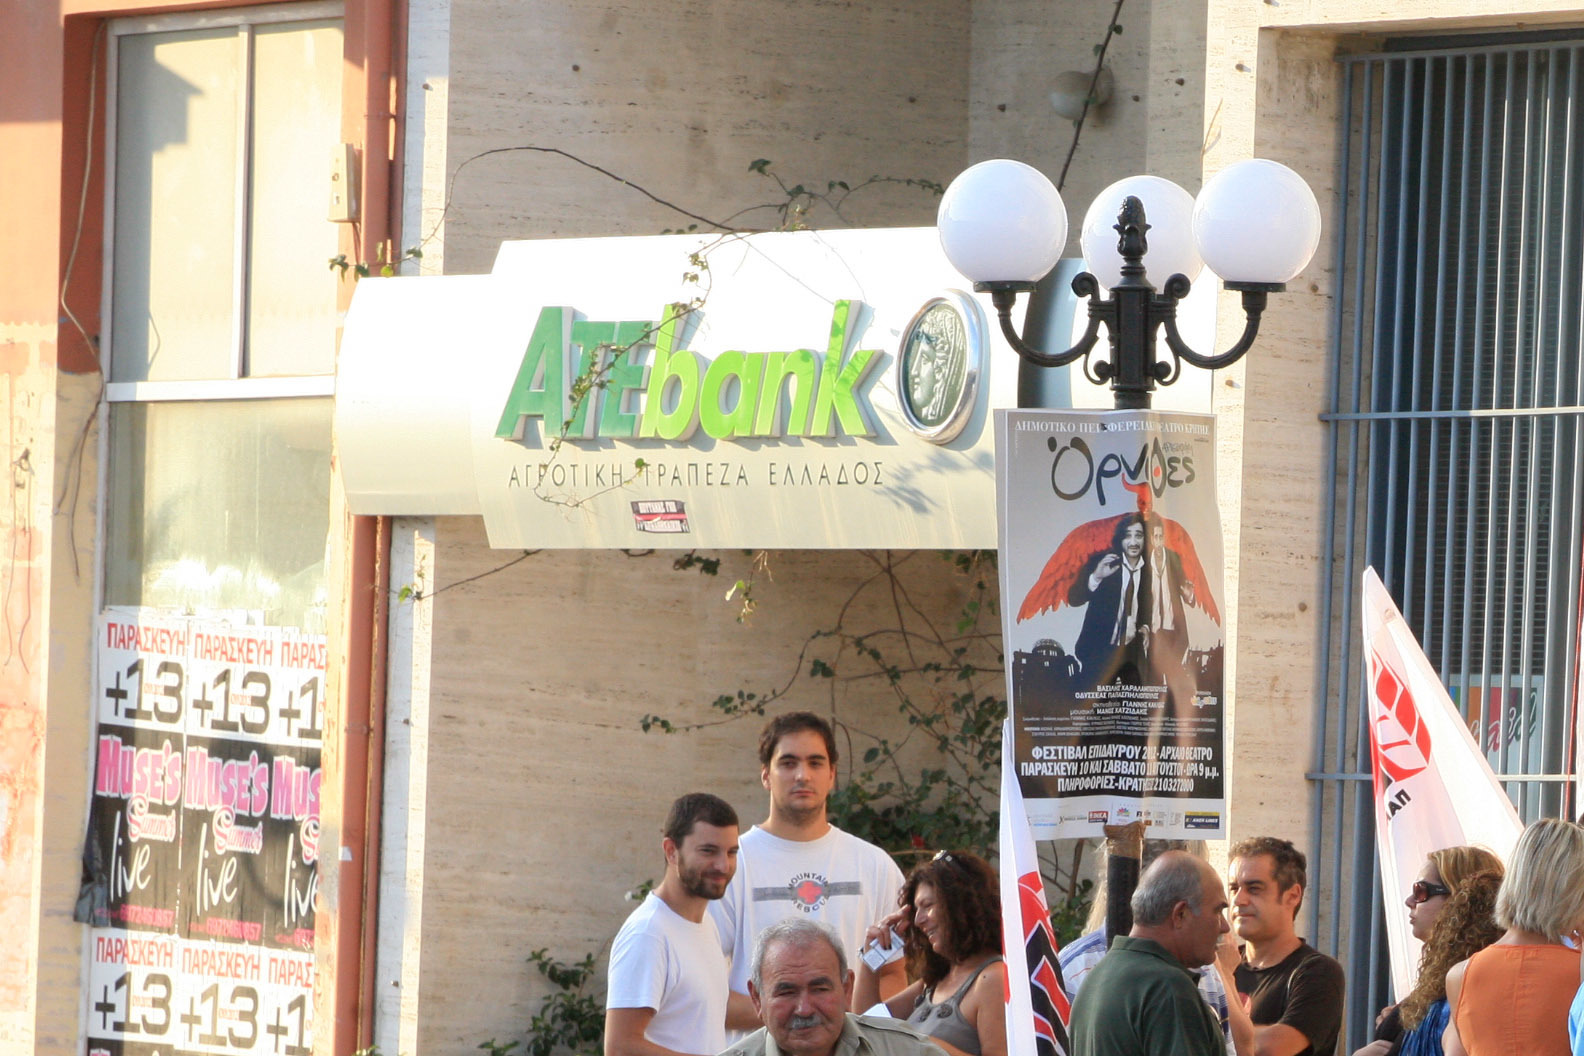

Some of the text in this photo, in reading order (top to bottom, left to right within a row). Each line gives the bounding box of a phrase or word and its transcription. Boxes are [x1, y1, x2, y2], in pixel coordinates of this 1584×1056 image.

[495, 300, 885, 441] ATEbank
[1015, 420, 1076, 432] ΔΗΜΟΤΙΚΟ
[508, 461, 884, 489] ΑΓΡΟΤΙΚΗ ΤΡΑΠΕΖΑ ΕΛΛΑΔΟΣ
[107, 622, 185, 656] ΠΑΡΑΣΚΕΥΗ
[194, 633, 273, 666] ΠΑΡΑΣΚΕΥΗ
[1021, 762, 1078, 776] ΠΑΡΑΣΚΕΥΗ
[1079, 761, 1089, 774] 10
[1090, 760, 1102, 774] ΚΑΙ
[1102, 760, 1146, 775] ΣΑΒΒΑΤΟ
[1199, 763, 1204, 776] 9
[1032, 746, 1087, 759] ΦΕΣΤΙΒΑΛ
[1088, 744, 1142, 760] ΕΠΙΔΑΥΡΟΥ
[110, 810, 151, 902] live
[196, 822, 238, 916] live
[787, 872, 829, 891] MOUNTAIN
[96, 937, 173, 968] ΠΑΡΑΣΚΕΥΗ
[182, 947, 261, 980] ΠΑΡΑΣΚΕΥΗ
